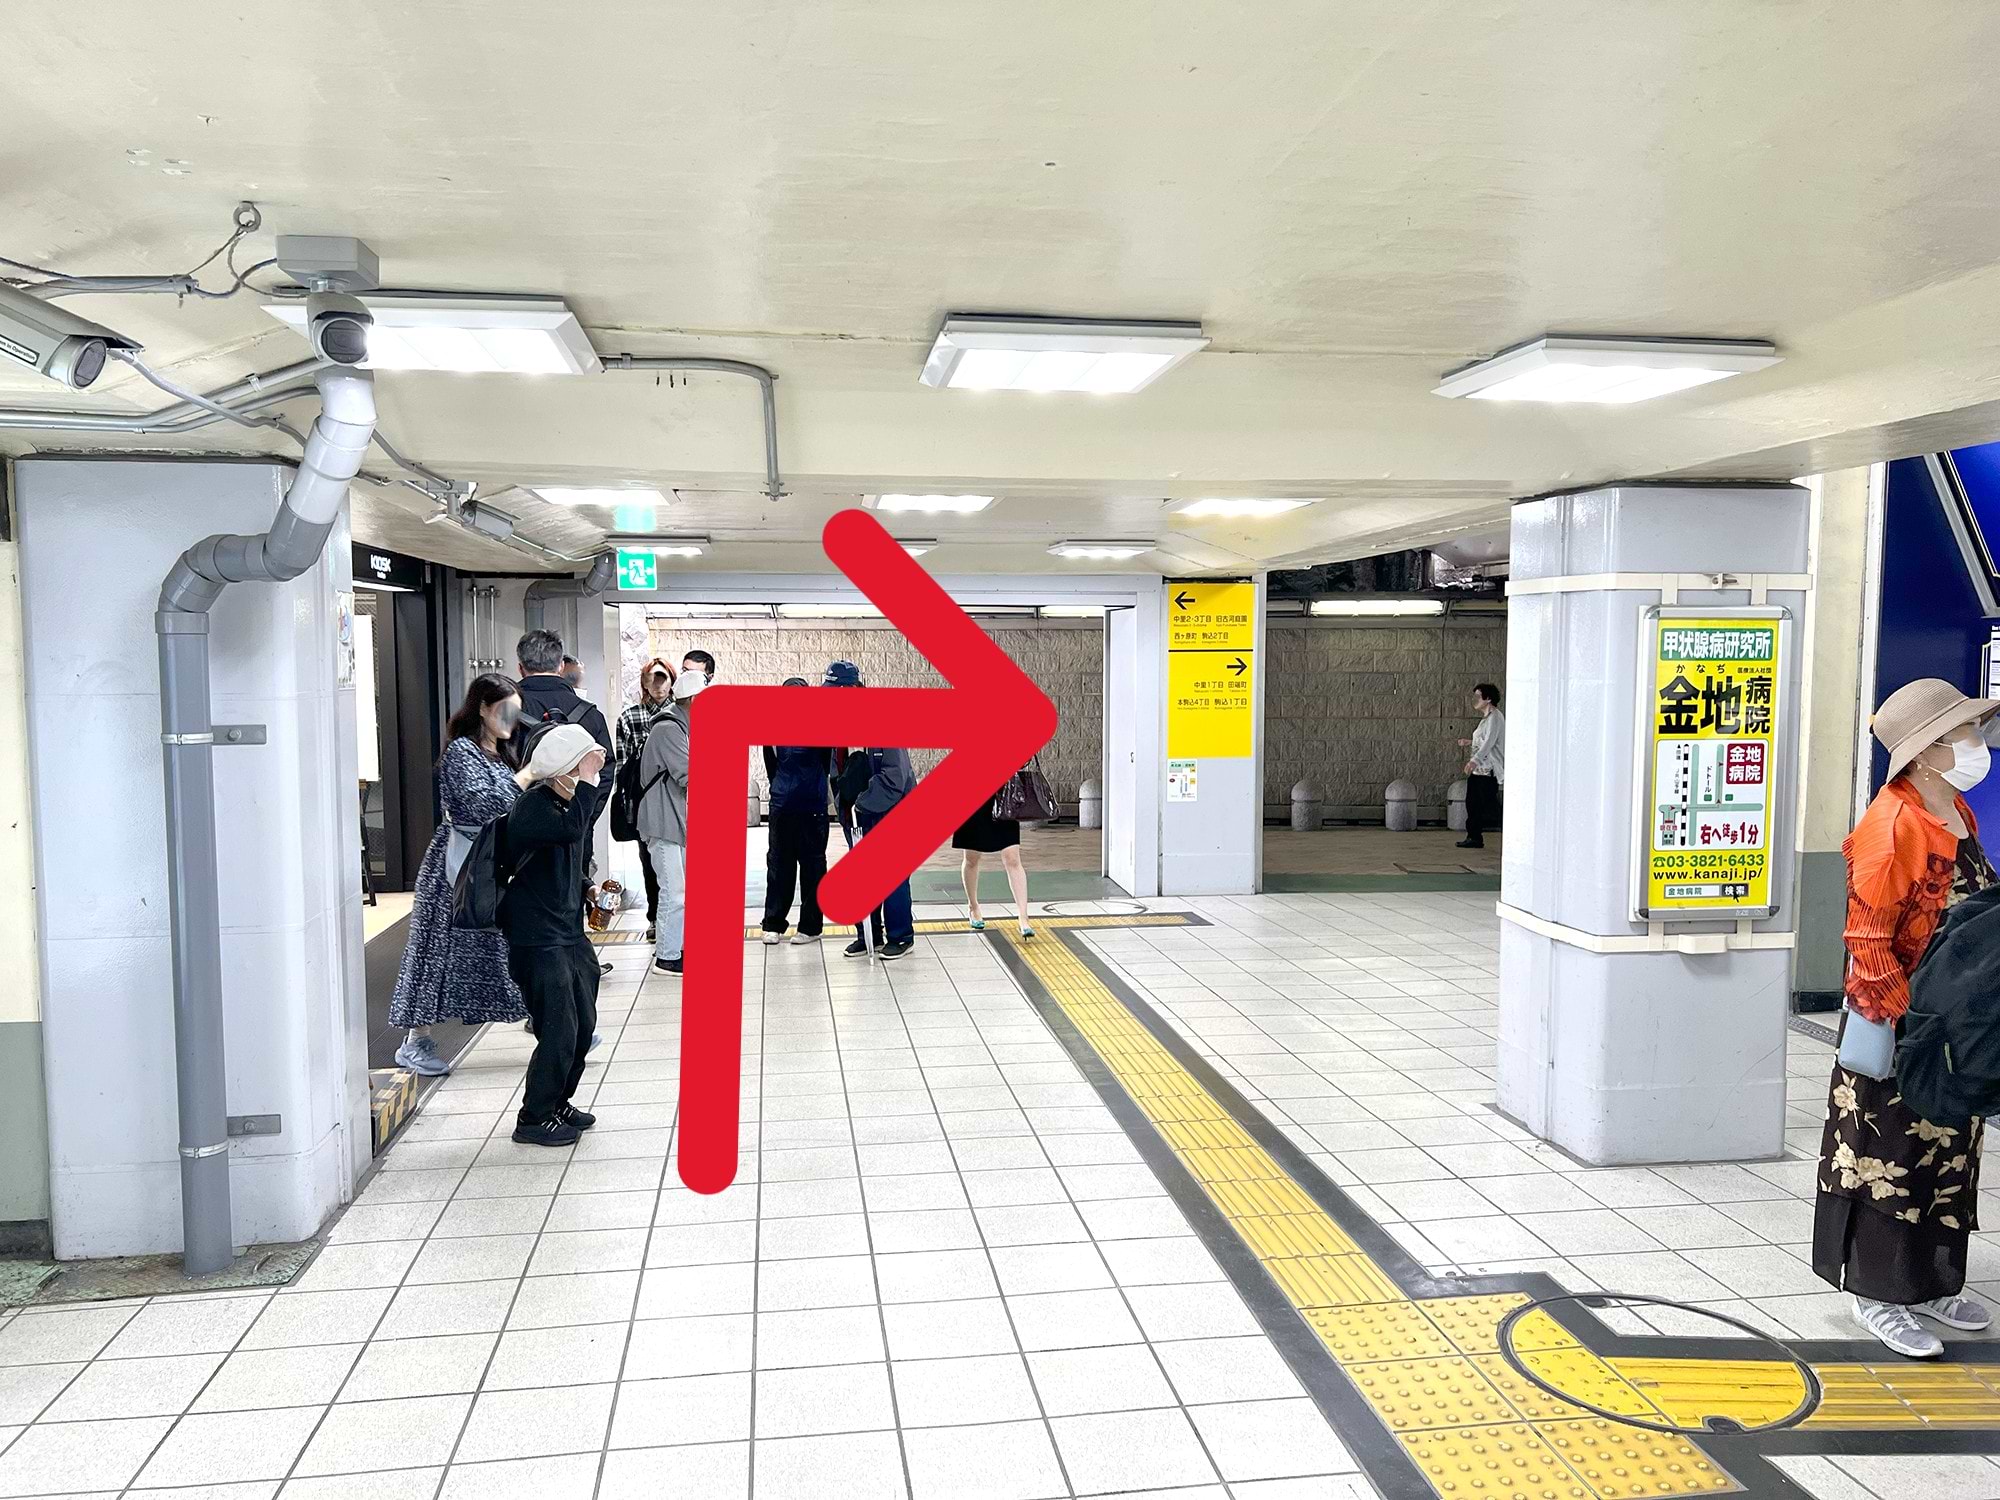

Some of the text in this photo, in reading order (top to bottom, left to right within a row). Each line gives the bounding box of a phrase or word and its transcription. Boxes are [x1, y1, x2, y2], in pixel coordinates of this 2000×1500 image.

[370, 554, 391, 572] KIOSK
[1664, 631, 1771, 659] 甲状腺病研究所
[1658, 675, 1772, 734] 金地 病院
[1729, 745, 1762, 763] 金地
[1704, 766, 1713, 793] ドトール
[1728, 765, 1761, 782] 病院
[1666, 854, 1765, 868] 03-3821-6433
[1653, 867, 1763, 881] www.kanaji.jp/
[1668, 887, 1702, 896] 金地病院
